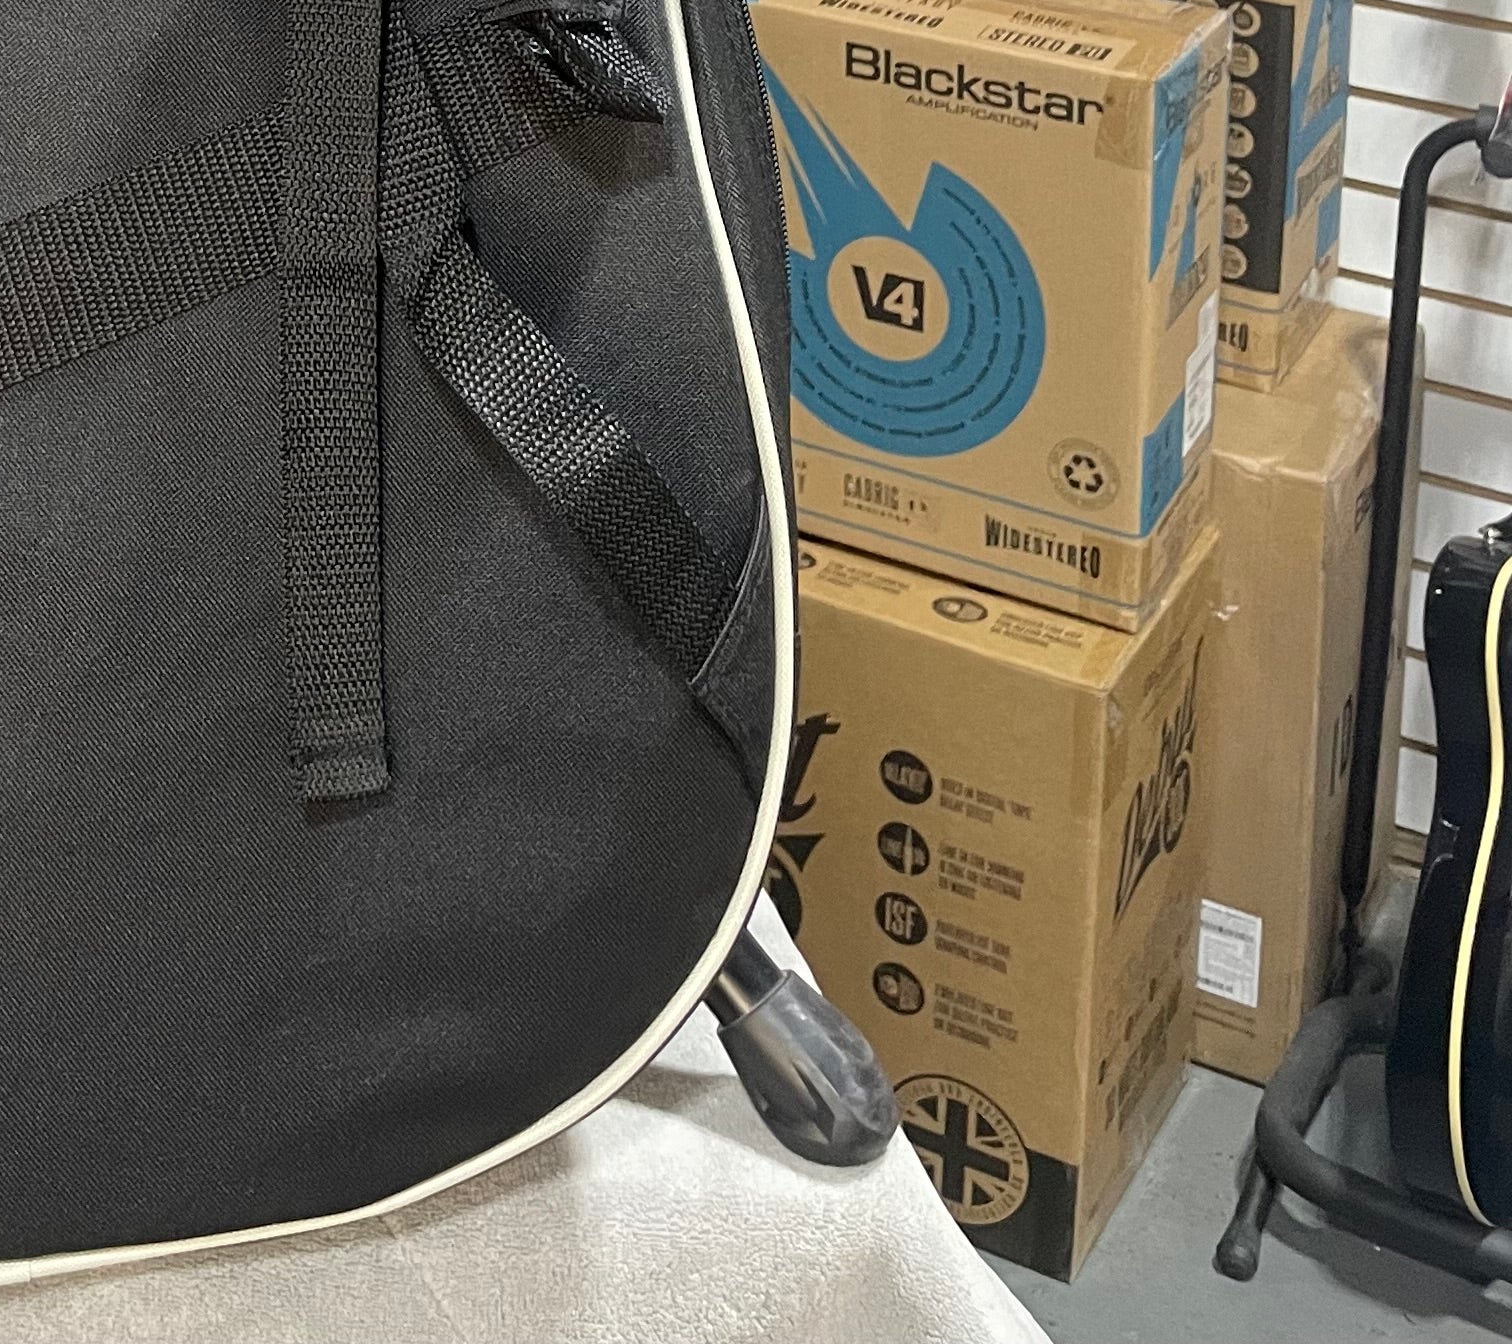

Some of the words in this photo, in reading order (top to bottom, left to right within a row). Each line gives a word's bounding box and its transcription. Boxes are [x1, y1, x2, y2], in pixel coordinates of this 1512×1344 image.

[988, 27, 1066, 52] STEREO
[845, 41, 1106, 126] Blackstar
[905, 93, 1039, 131] AMPLIFICATION
[851, 264, 925, 332] V4
